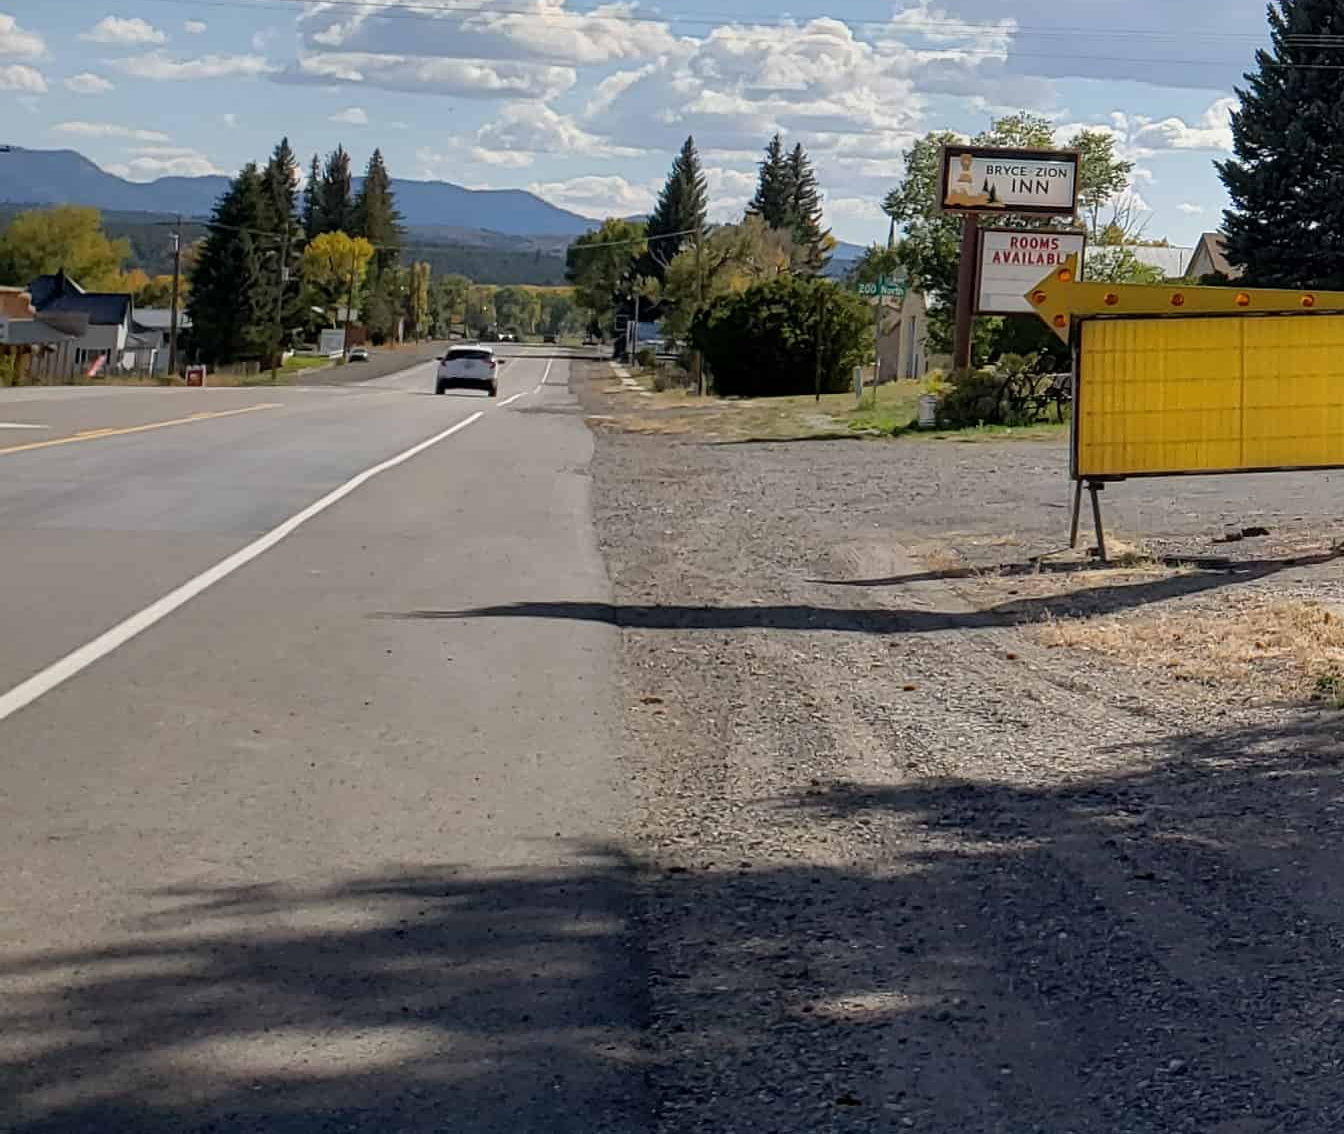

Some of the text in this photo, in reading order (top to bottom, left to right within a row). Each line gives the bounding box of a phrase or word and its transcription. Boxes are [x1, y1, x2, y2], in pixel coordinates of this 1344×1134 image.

[1035, 167, 1068, 179] ZION
[1011, 177, 1050, 195] INN
[1010, 236, 1060, 250] ROOMS
[992, 250, 1073, 266] AVAILABL
